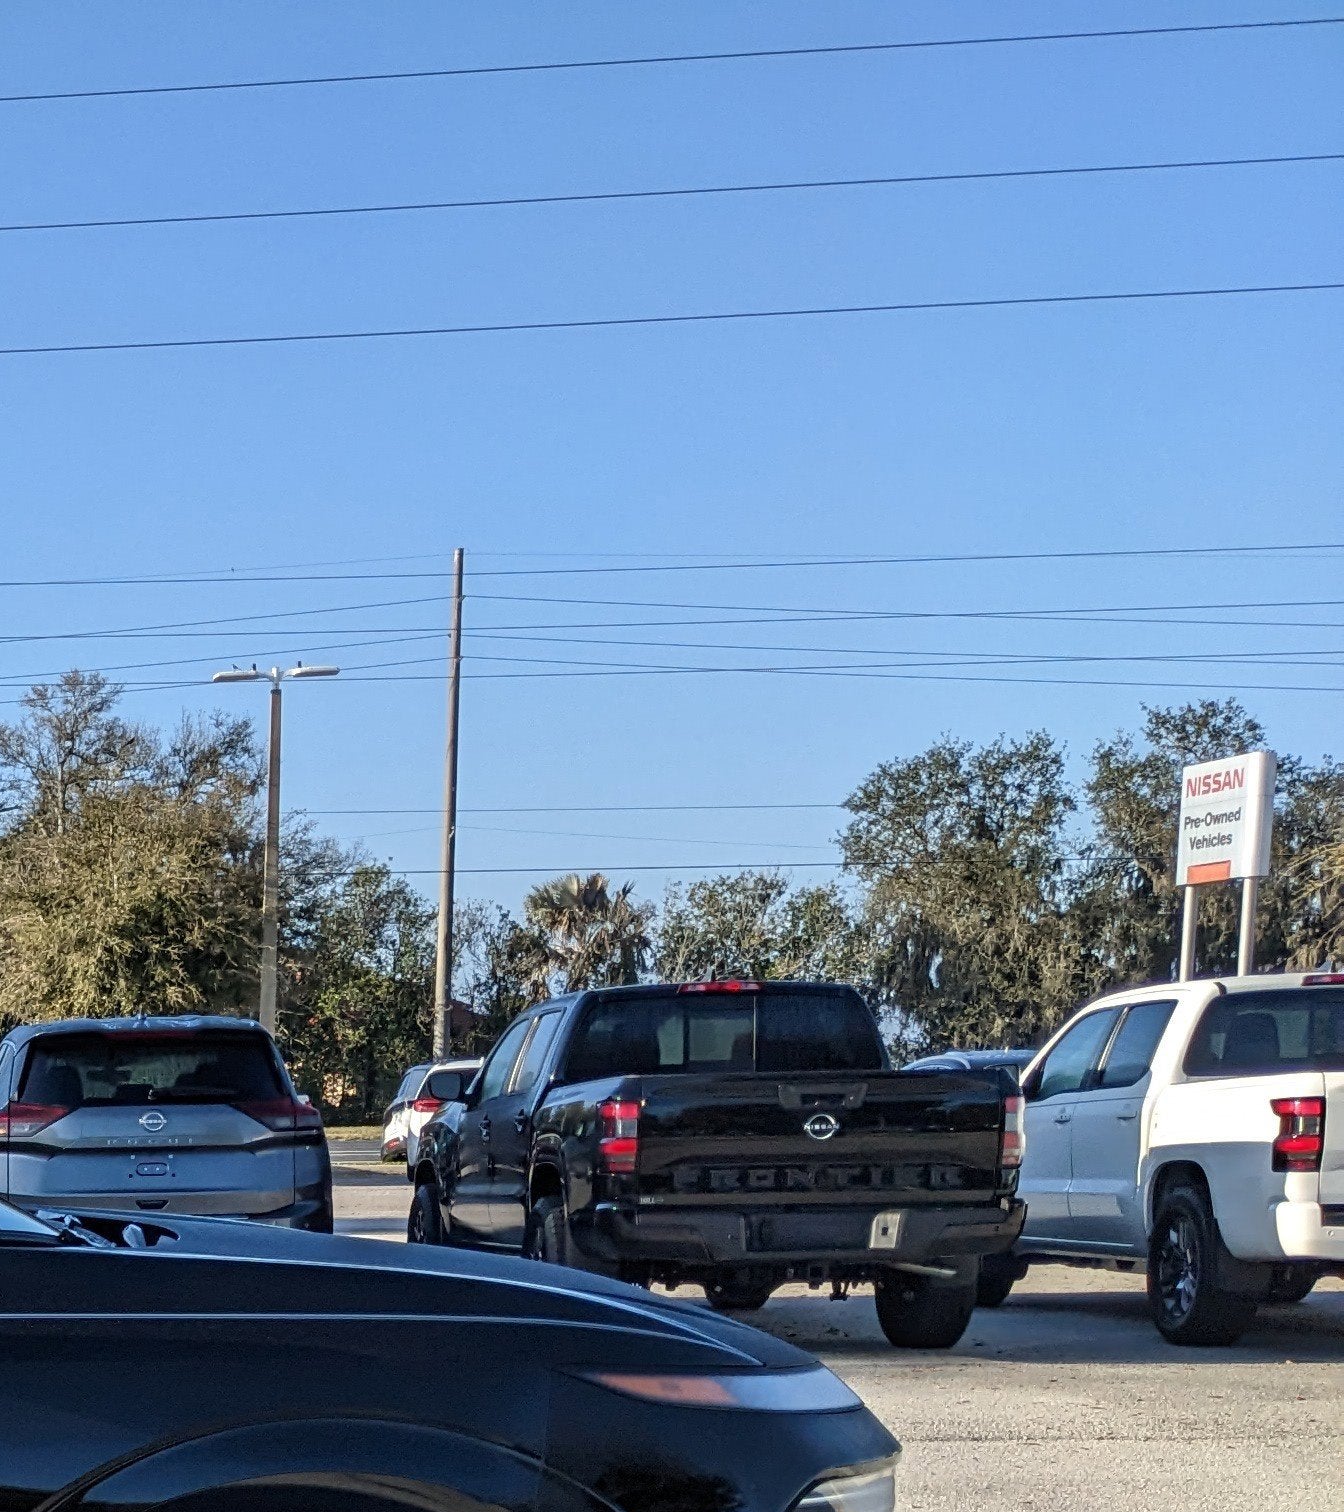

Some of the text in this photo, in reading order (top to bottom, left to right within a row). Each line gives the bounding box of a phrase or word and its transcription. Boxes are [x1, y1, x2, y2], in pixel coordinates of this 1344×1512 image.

[1186, 768, 1244, 798] NISSAN
[1184, 807, 1241, 830] Pre-Owned
[1190, 832, 1233, 850] Vehicles
[673, 1165, 963, 1190] FRONTIER
